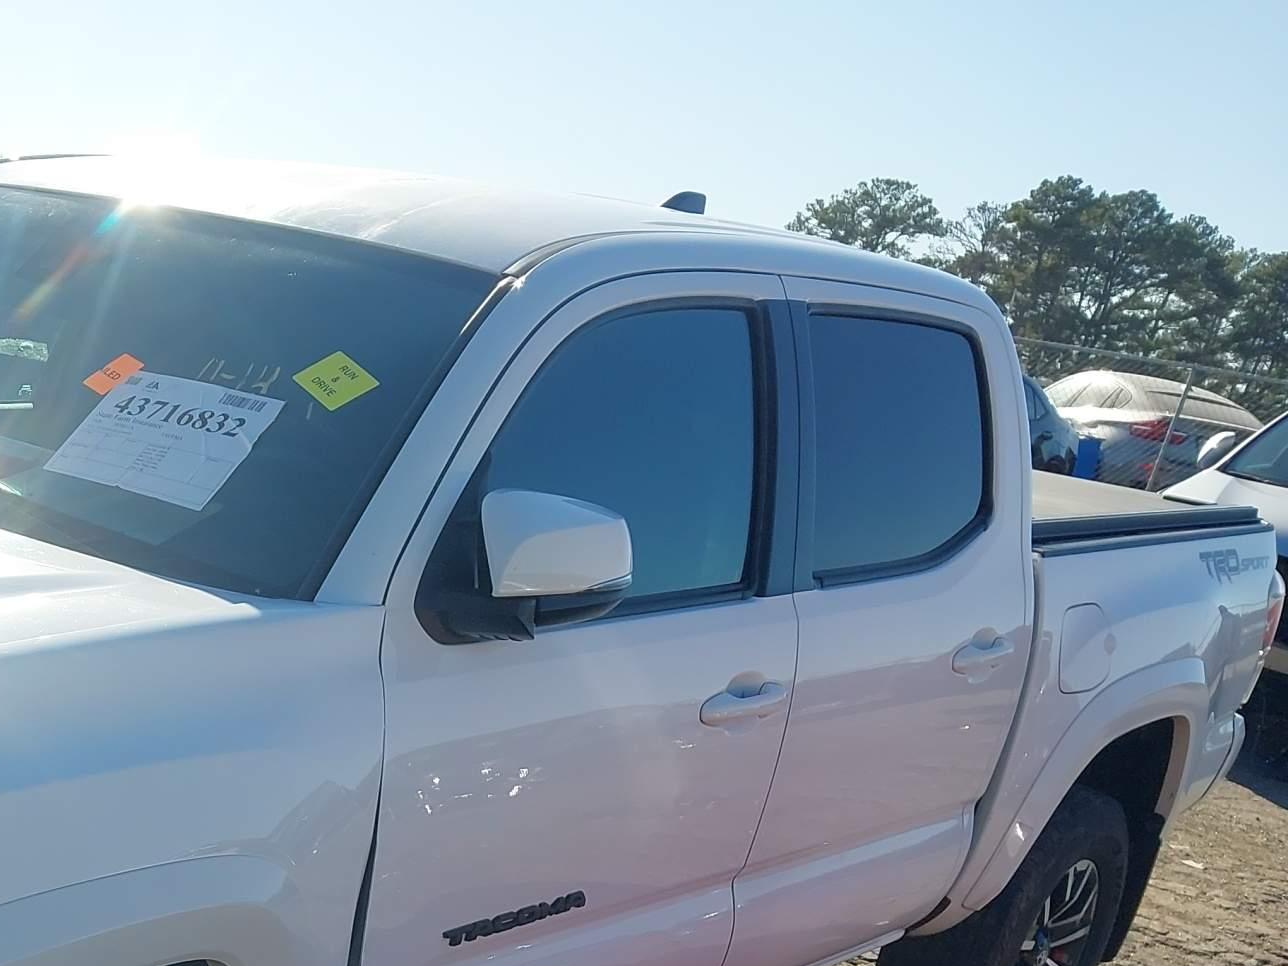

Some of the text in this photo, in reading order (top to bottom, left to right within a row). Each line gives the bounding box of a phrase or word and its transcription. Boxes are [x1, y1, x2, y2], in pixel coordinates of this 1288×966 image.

[312, 376, 337, 397] DRIVE
[339, 365, 360, 381] RUN
[114, 395, 246, 437] 43716832
[1199, 549, 1270, 585] TRD SPORT
[442, 890, 586, 947] TACOMA
